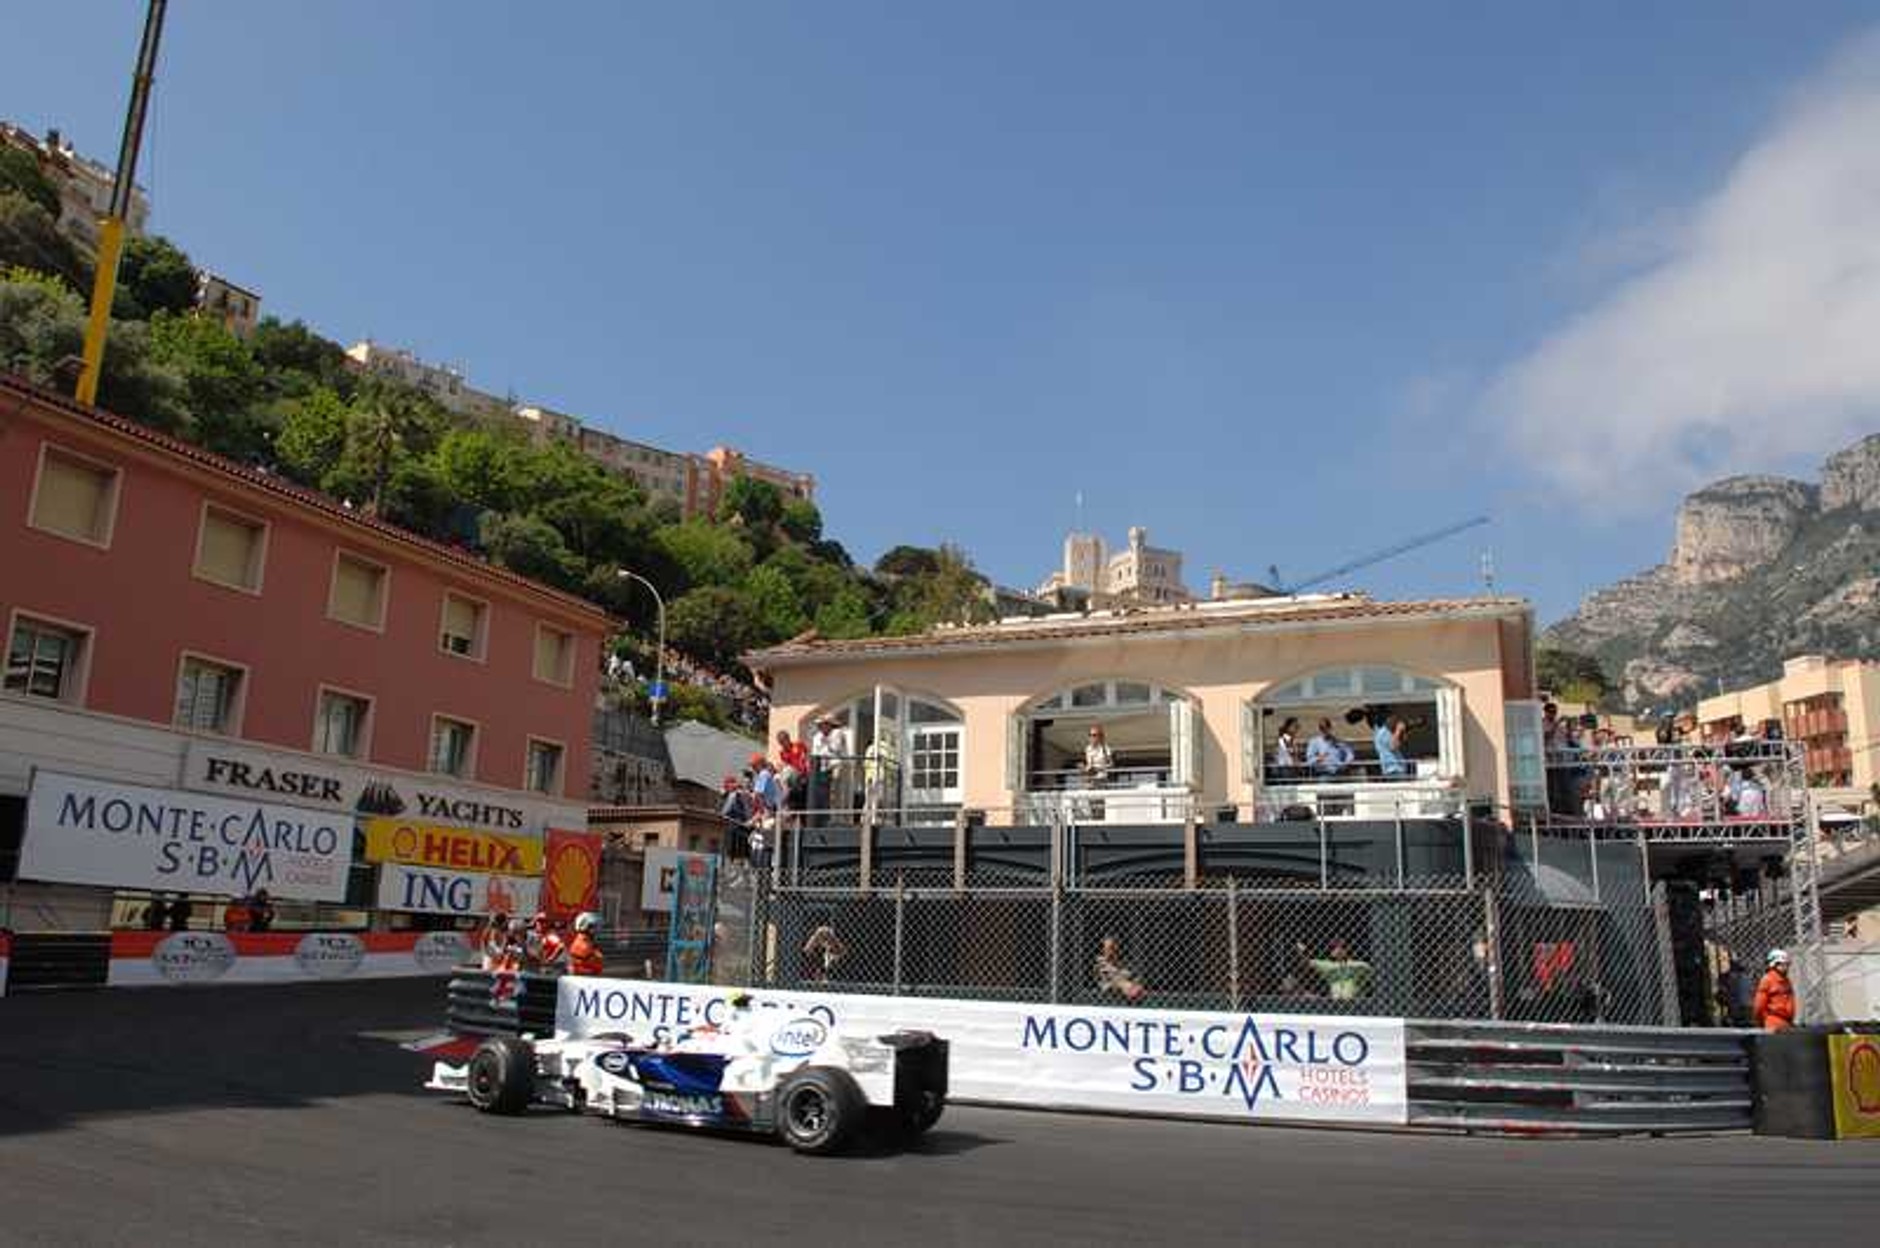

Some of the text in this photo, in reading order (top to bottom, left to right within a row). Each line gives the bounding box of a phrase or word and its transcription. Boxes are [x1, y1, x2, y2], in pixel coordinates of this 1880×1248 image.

[206, 757, 524, 828] FRASER YACHTS
[423, 833, 526, 871] HELIX
[403, 873, 472, 911] ING
[1300, 1067, 1369, 1085] HOTELS
